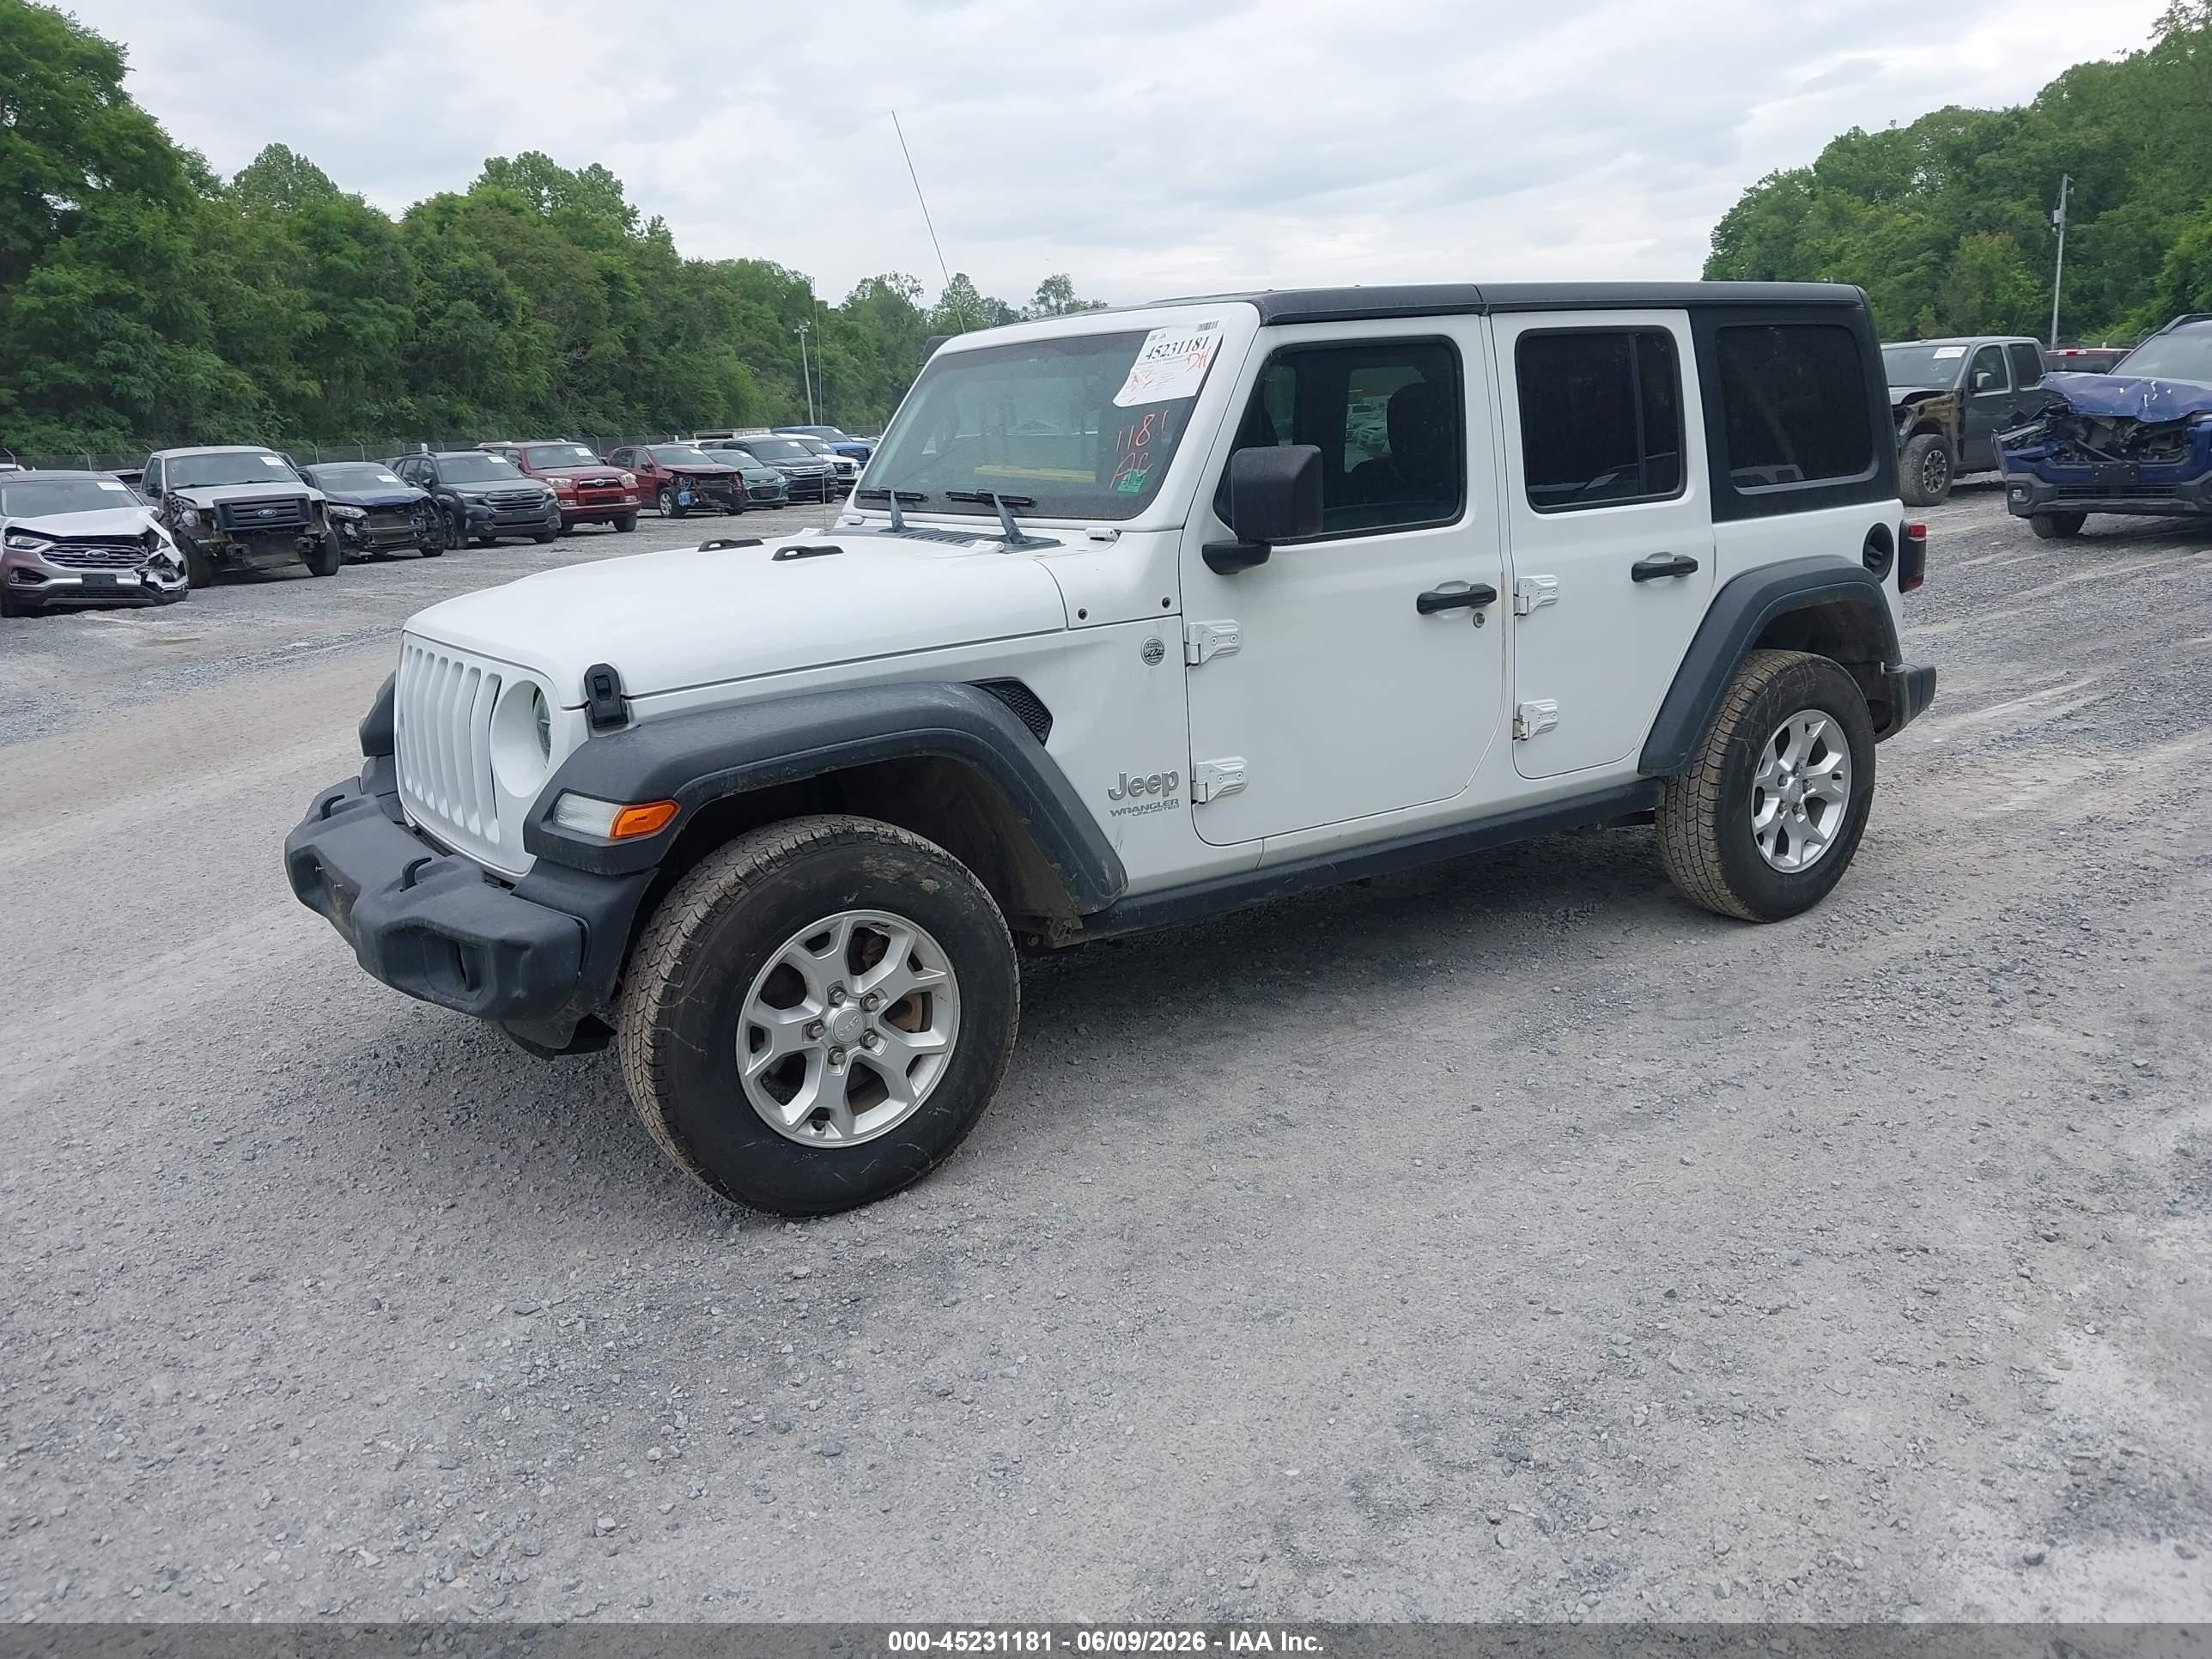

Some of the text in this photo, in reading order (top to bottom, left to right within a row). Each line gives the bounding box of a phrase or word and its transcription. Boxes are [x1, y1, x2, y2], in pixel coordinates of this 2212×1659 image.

[1146, 335, 1210, 360] 45231181
[1116, 410, 1169, 453] 1181
[1108, 770, 1179, 800] Jeep
[1109, 799, 1179, 817] WRANGLER
